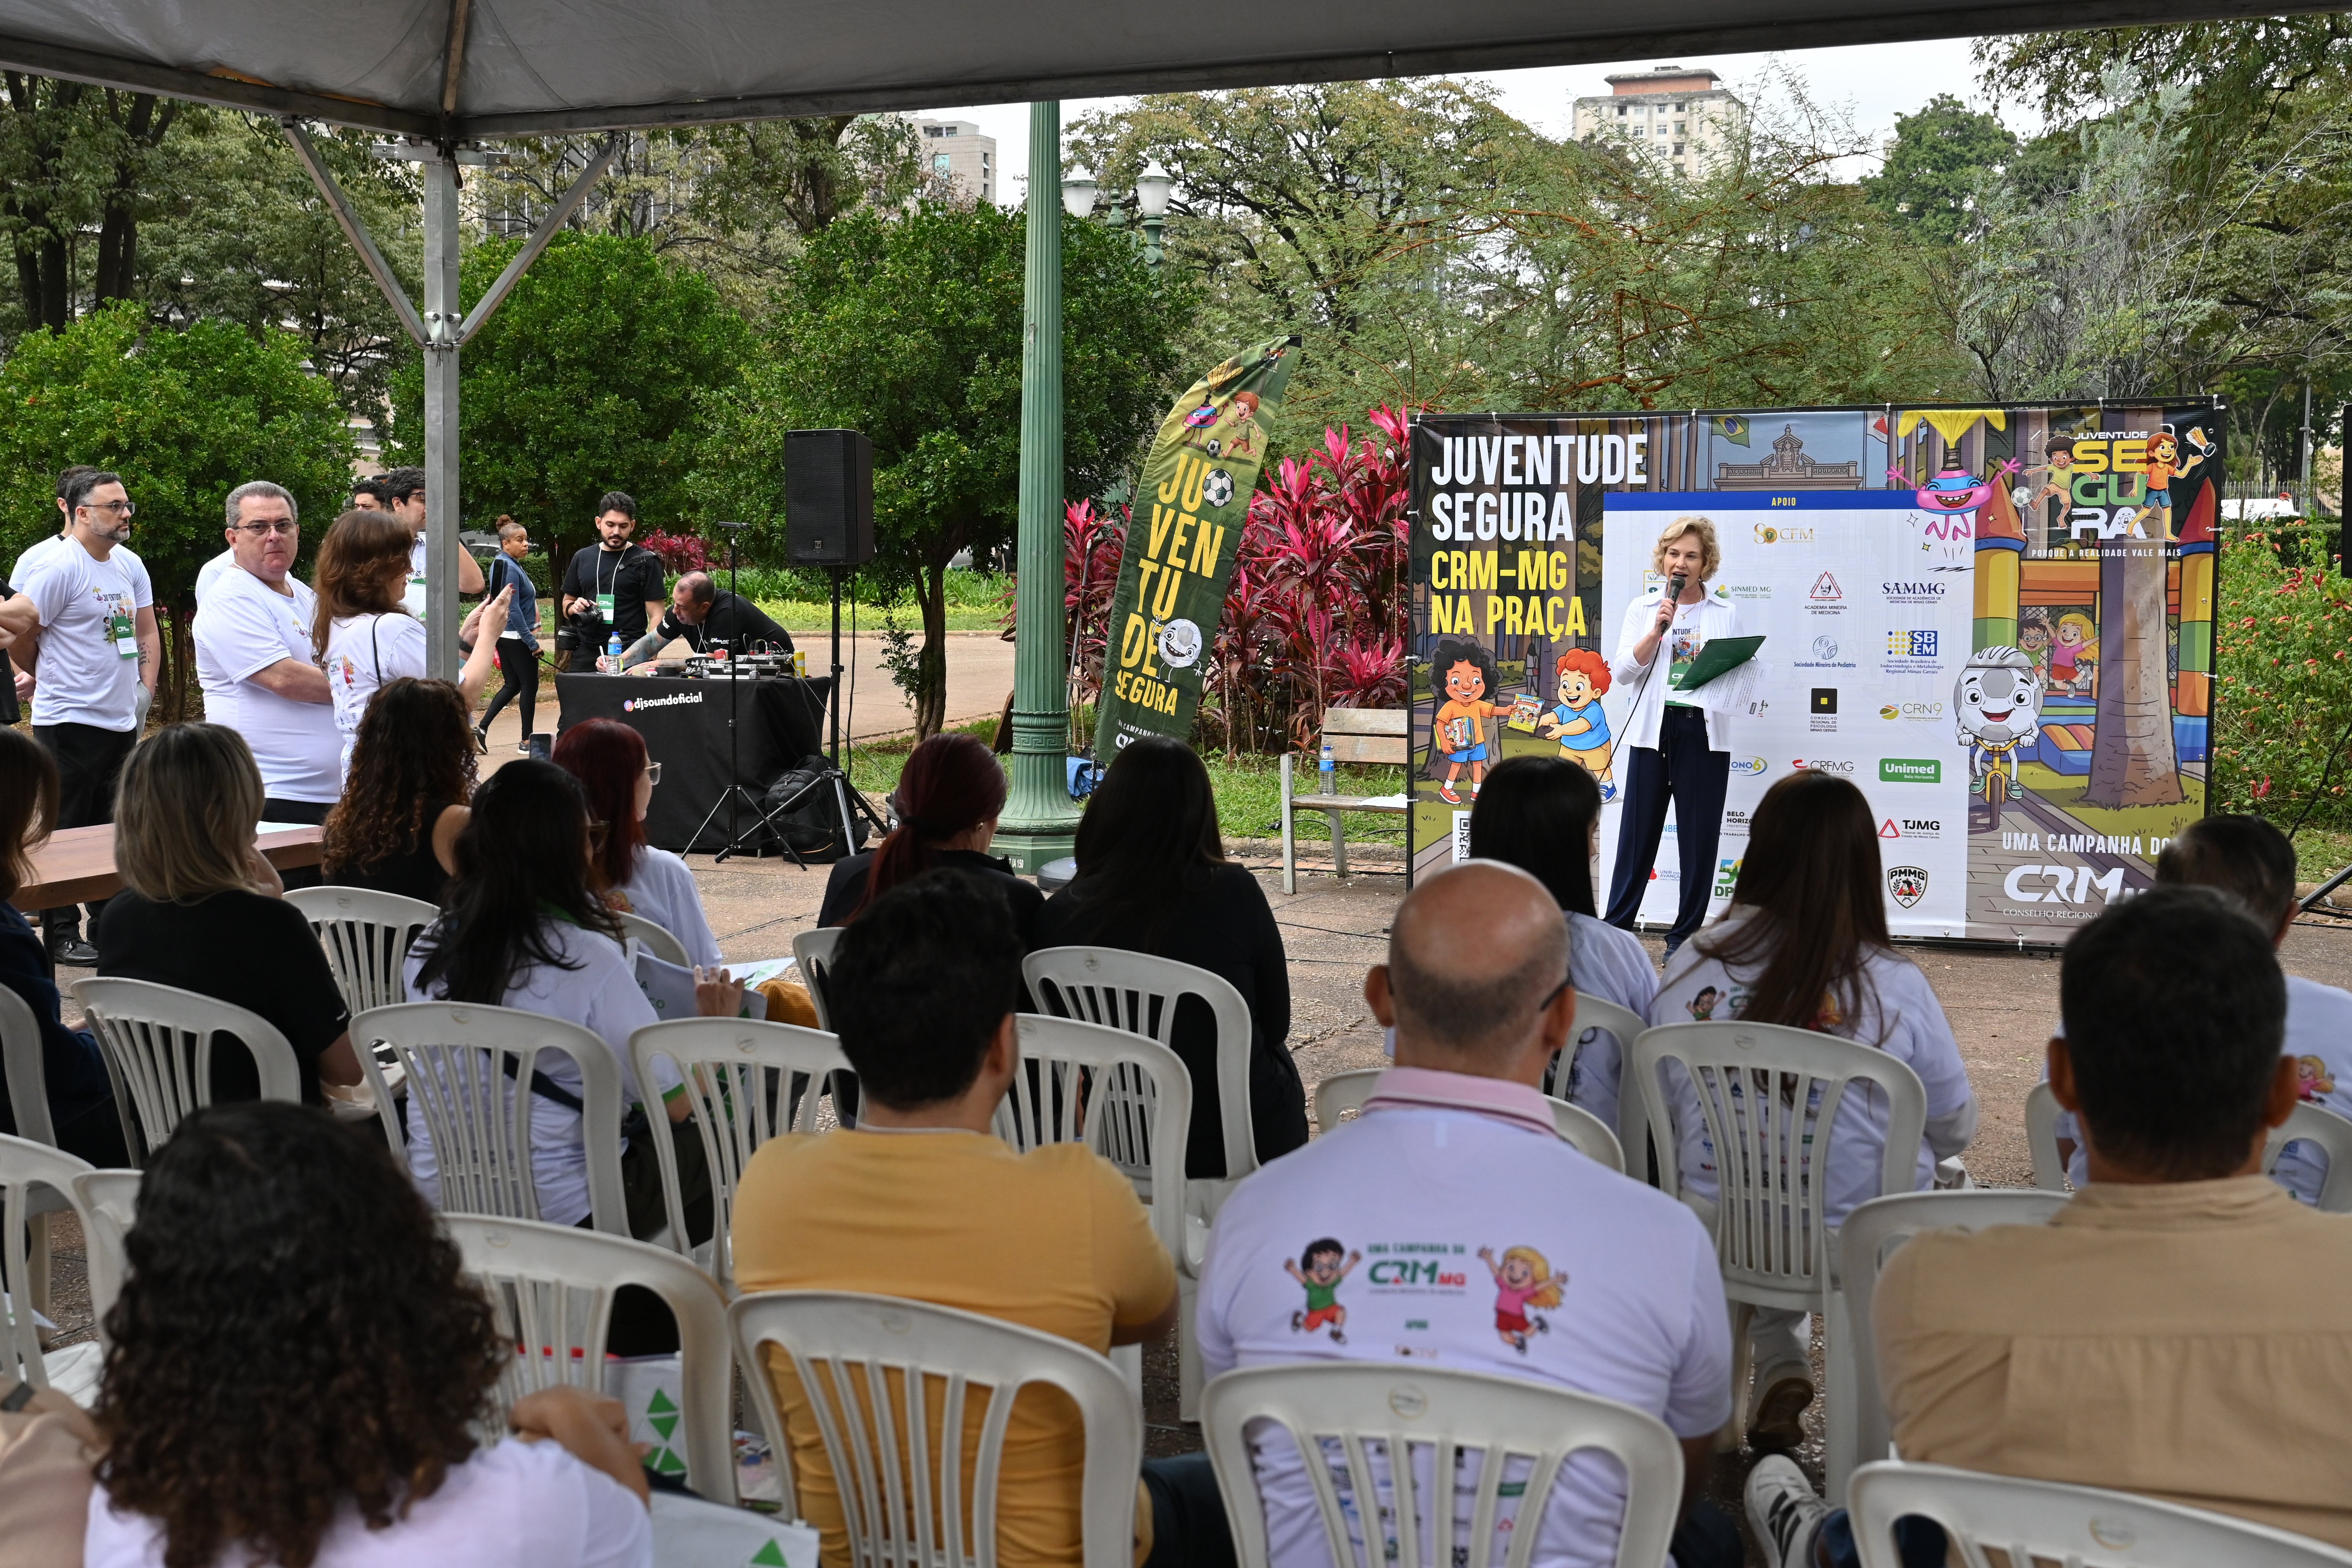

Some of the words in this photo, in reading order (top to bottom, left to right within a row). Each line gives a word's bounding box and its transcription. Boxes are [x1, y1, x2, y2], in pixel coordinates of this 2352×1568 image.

[2074, 431, 2148, 440] JUVENTUDE
[1432, 434, 1647, 485] JUVENTUDE
[2072, 440, 2148, 472] SE
[1158, 453, 1211, 513] JU
[2071, 474, 2147, 506] GU
[1771, 497, 1796, 506] APOIO
[1432, 492, 1574, 541] SEGURA
[2071, 507, 2147, 539] RA
[1147, 503, 1225, 578] VEN
[1780, 528, 1814, 540] CFM
[1432, 551, 1567, 590] CRM-MG
[1138, 558, 1182, 621] TU
[1882, 583, 1945, 594] SAMMG
[1431, 595, 1474, 634] NA
[1486, 596, 1587, 643] PRAÇA
[1120, 612, 1165, 678] DE
[1913, 632, 1935, 643] SB
[1913, 644, 1935, 655] EM
[1115, 669, 1178, 716] SEGURA
[1903, 703, 1942, 716] CRN9
[1123, 723, 1154, 737] CAMPANHA
[1731, 759, 1761, 770] ONO6
[1810, 760, 1854, 771] CRFMG
[1885, 763, 1934, 773] Unimed
[1902, 820, 1940, 830] TJMG
[2002, 832, 2039, 851] UMA
[2047, 833, 2142, 855] CAMPANHA
[1890, 869, 1925, 881] PMMG
[1715, 886, 1734, 897] DP
[2004, 865, 2124, 905] CRM
[2003, 908, 2054, 918] CONSELHO
[1369, 1259, 1439, 1284] CRM
[1439, 1272, 1466, 1287] MG
